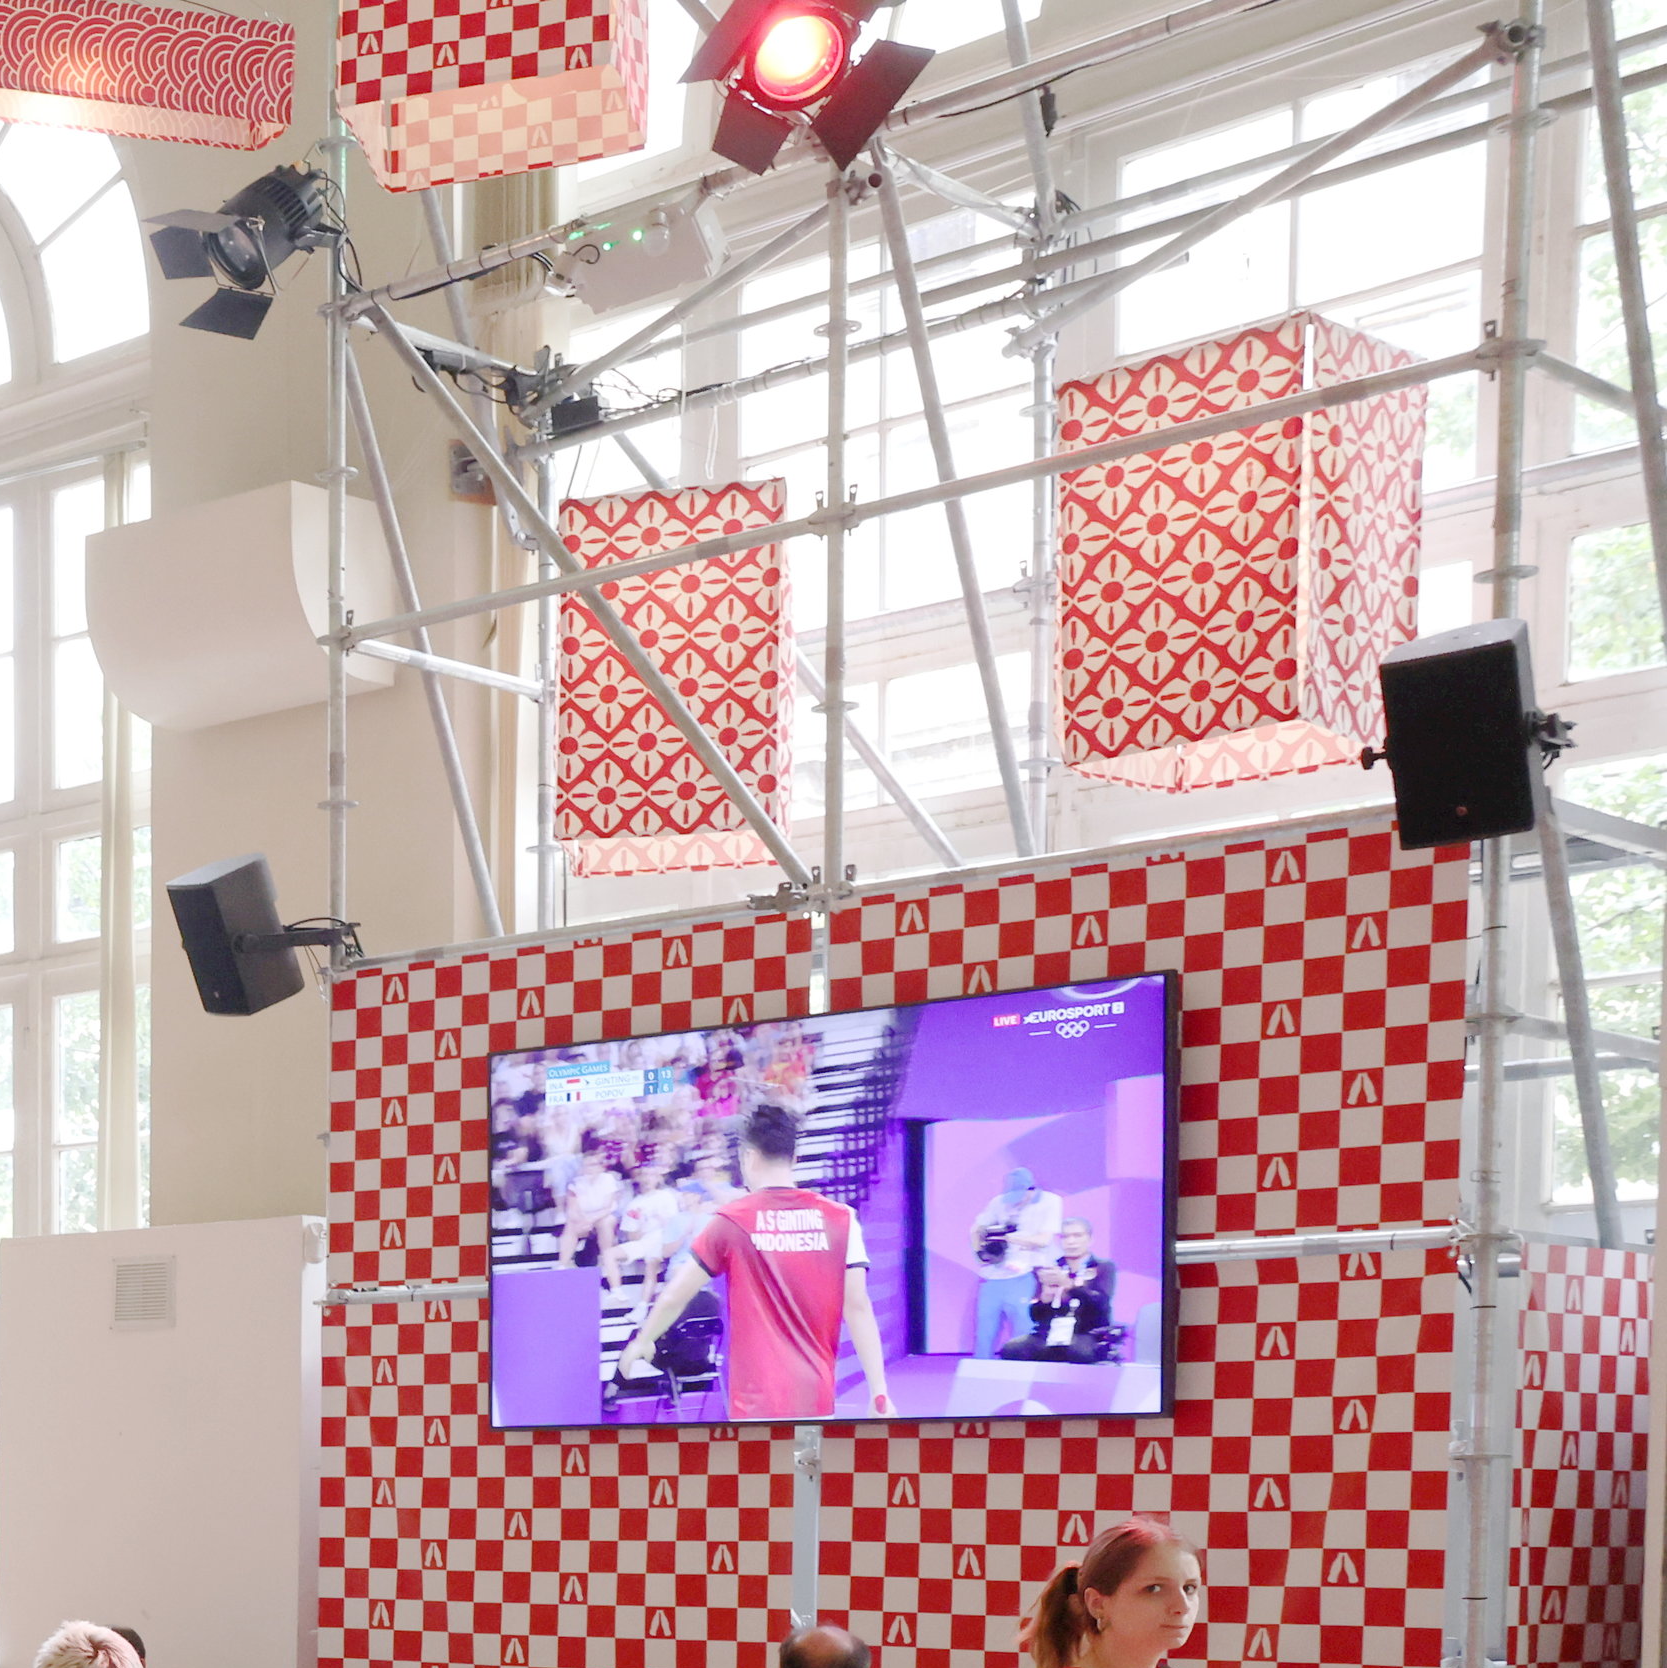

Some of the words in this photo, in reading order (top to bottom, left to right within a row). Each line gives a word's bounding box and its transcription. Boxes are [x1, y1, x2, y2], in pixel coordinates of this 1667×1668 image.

[993, 1015, 1017, 1027] LIVE
[1023, 1003, 1111, 1024] EUROSPORT
[548, 1066, 580, 1078] OLYMPIC
[582, 1062, 609, 1074] GAMES
[648, 1072, 655, 1081] 0
[661, 1069, 671, 1079] 13
[755, 1210, 766, 1231] A
[766, 1210, 776, 1231] S
[776, 1208, 824, 1231] GINTING
[751, 1231, 829, 1252] INDONESIA
